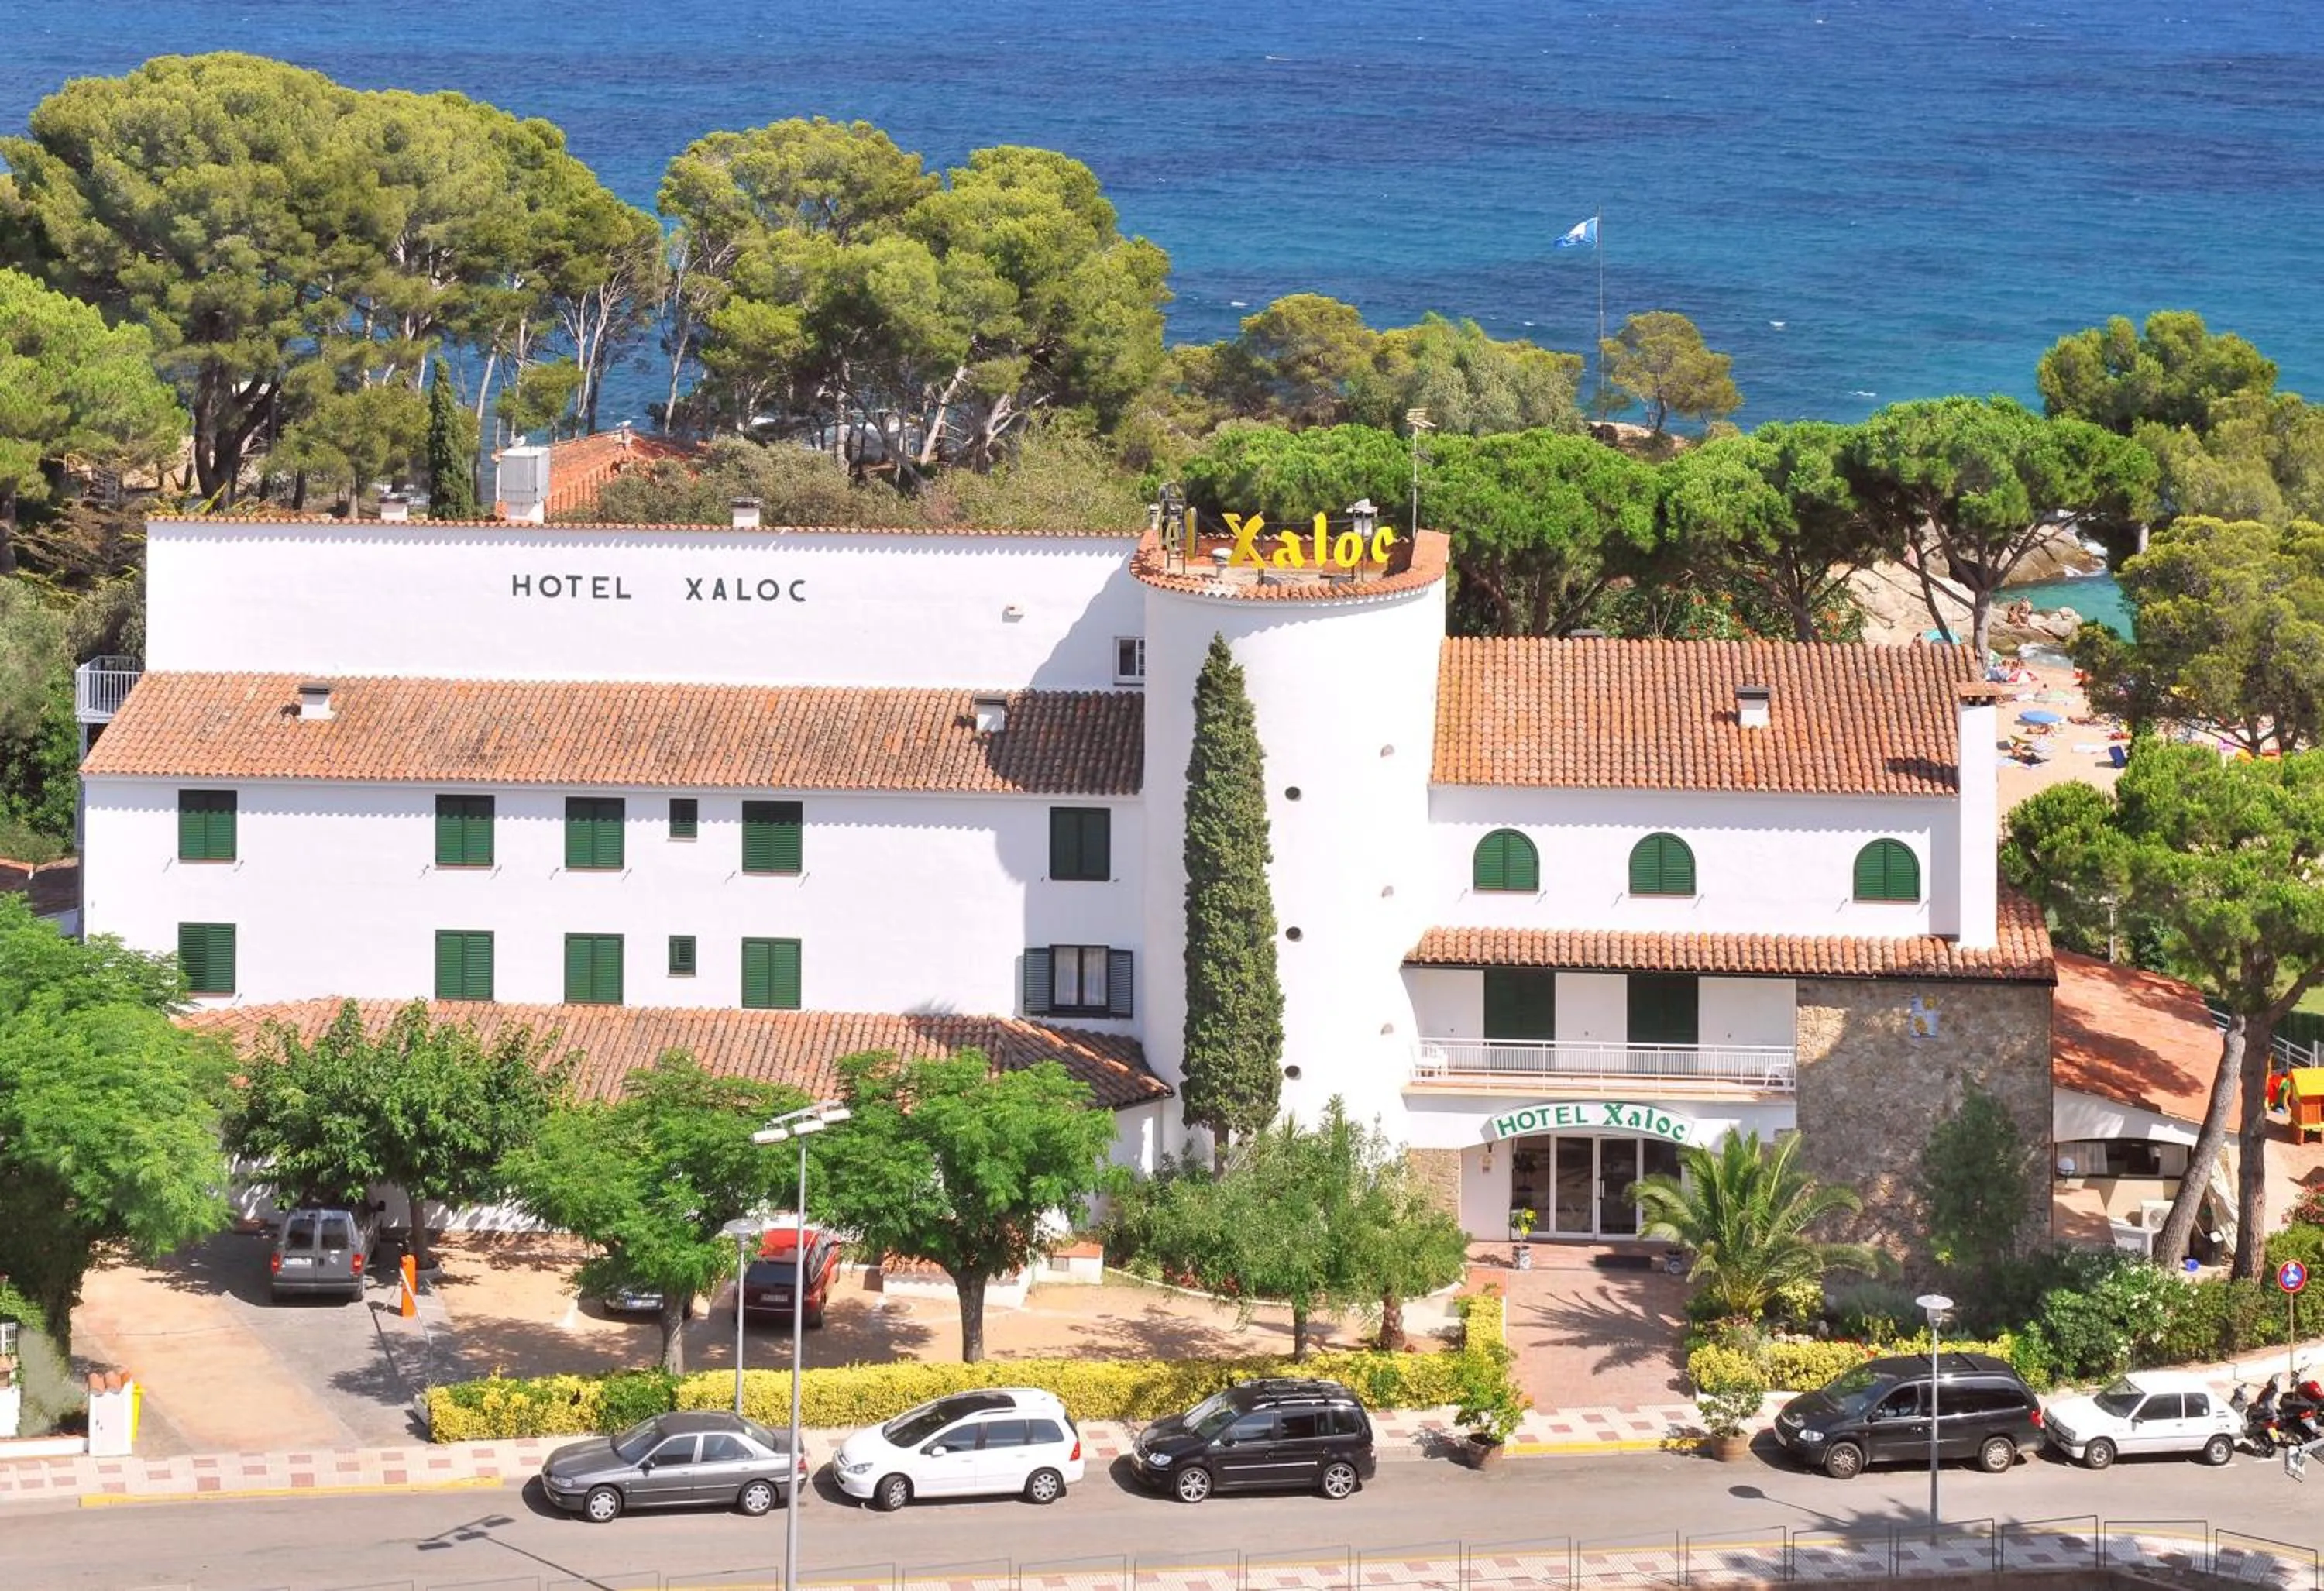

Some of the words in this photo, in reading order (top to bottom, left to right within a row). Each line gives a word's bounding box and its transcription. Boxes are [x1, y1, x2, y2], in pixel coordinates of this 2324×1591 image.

[1222, 511, 1396, 569] Xaloc
[511, 574, 632, 599] HOTEL
[686, 577, 806, 601] XALOC
[1496, 1105, 1590, 1136] HOTEL
[1603, 1103, 1686, 1141] Xaloc
